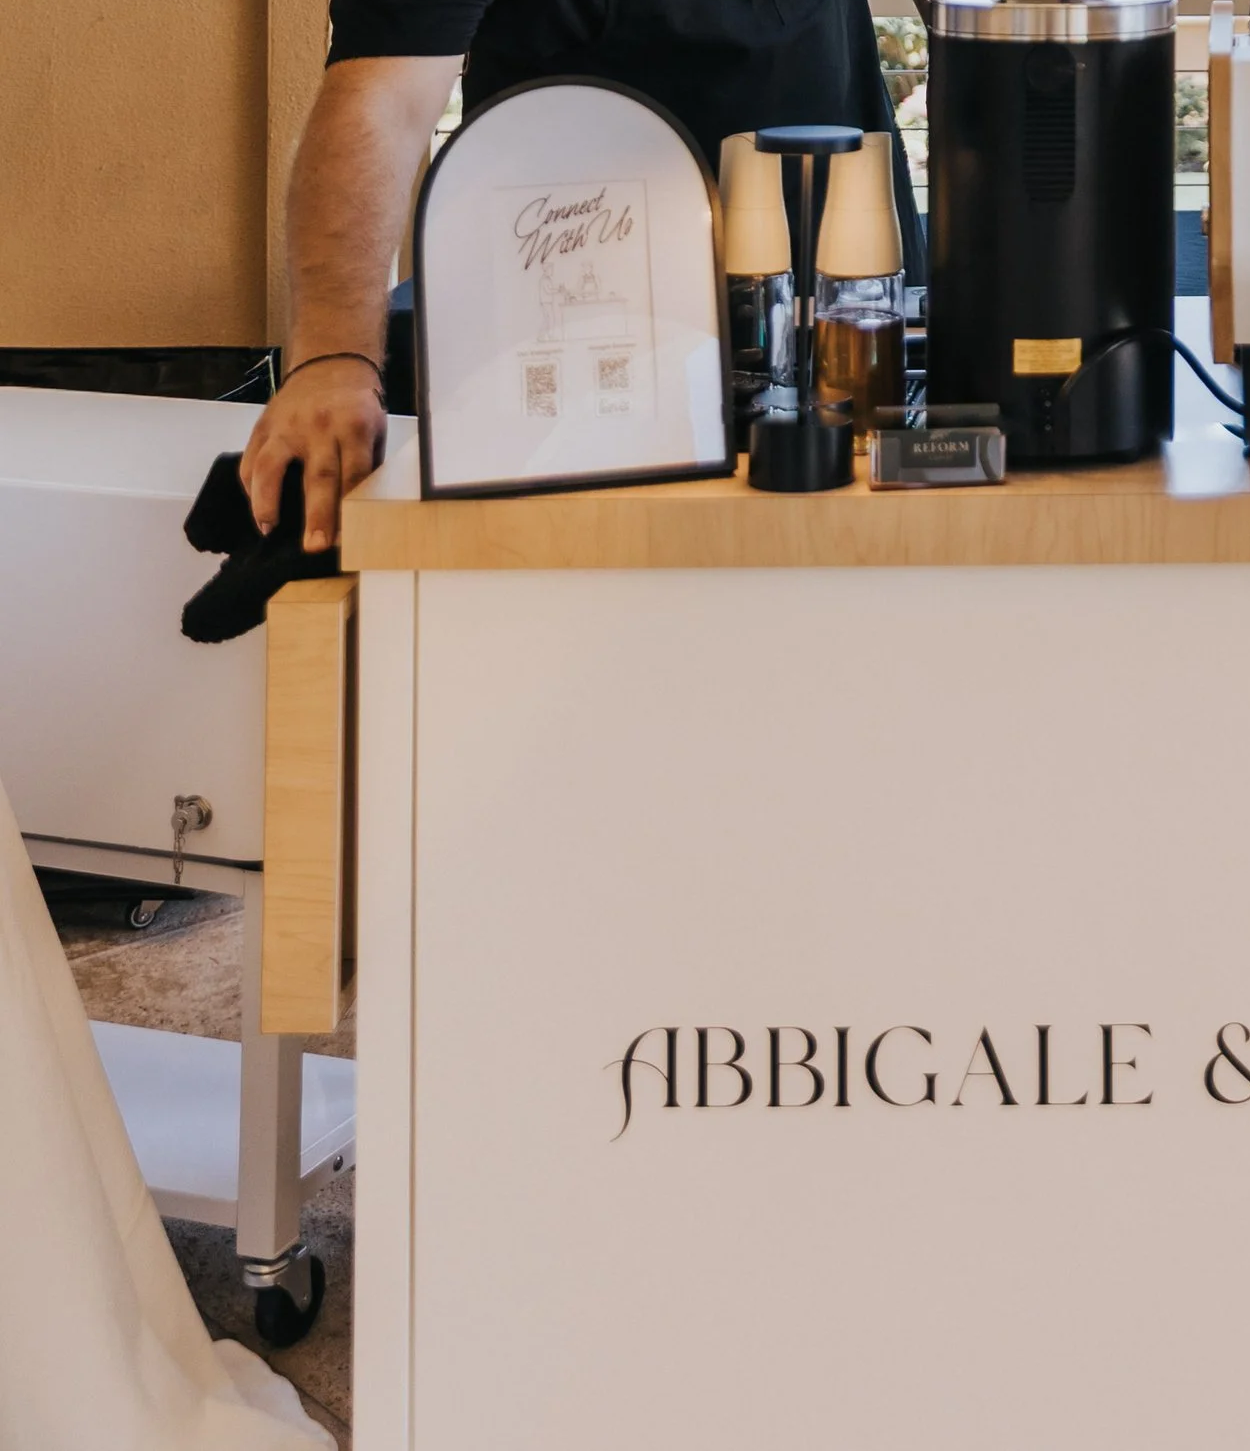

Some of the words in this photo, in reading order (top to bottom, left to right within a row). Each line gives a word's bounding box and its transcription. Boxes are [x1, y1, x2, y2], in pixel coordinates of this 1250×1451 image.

[514, 187, 607, 239] Connect
[518, 222, 586, 271] With
[584, 204, 633, 244] Us
[913, 440, 970, 453] REFORM
[602, 1023, 1154, 1143] ABBIGALE
